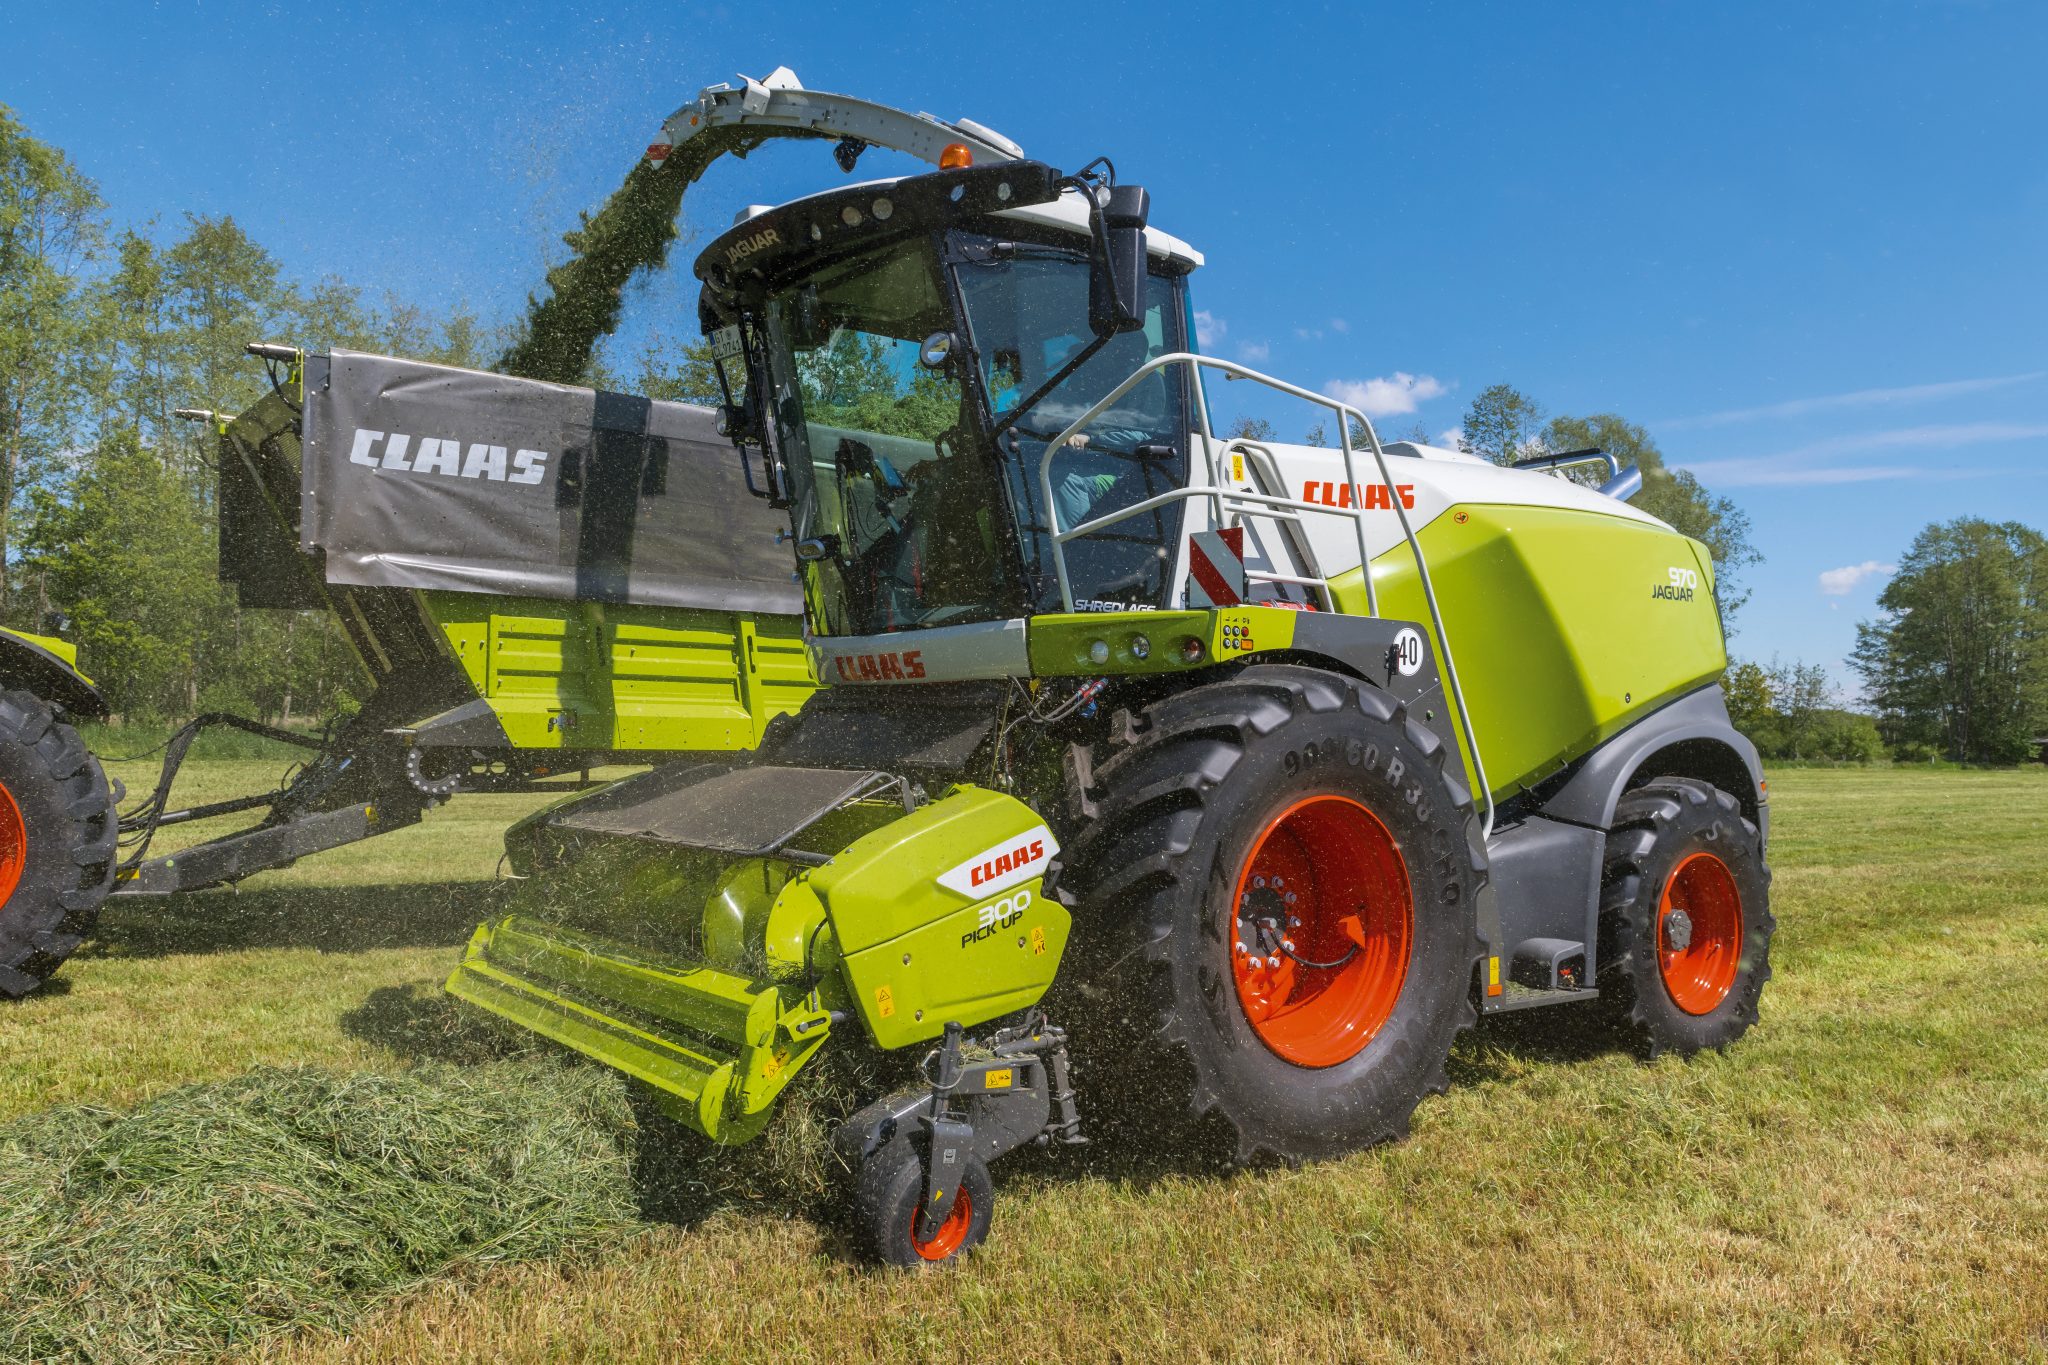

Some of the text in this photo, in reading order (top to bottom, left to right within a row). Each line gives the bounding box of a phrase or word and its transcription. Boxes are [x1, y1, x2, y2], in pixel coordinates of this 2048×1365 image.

[725, 229, 780, 264] JAGUAR
[350, 429, 548, 485] CLAAS
[1303, 480, 1414, 510] CLAAS
[1652, 584, 1694, 602] JAGUAR
[1668, 566, 1697, 590] 970
[835, 650, 926, 681] CLAAS
[1399, 636, 1417, 666] 40
[1384, 756, 1406, 788] R
[971, 839, 1044, 887] CLAAS
[978, 889, 1032, 929] 300
[961, 910, 1023, 949] PICK UP
